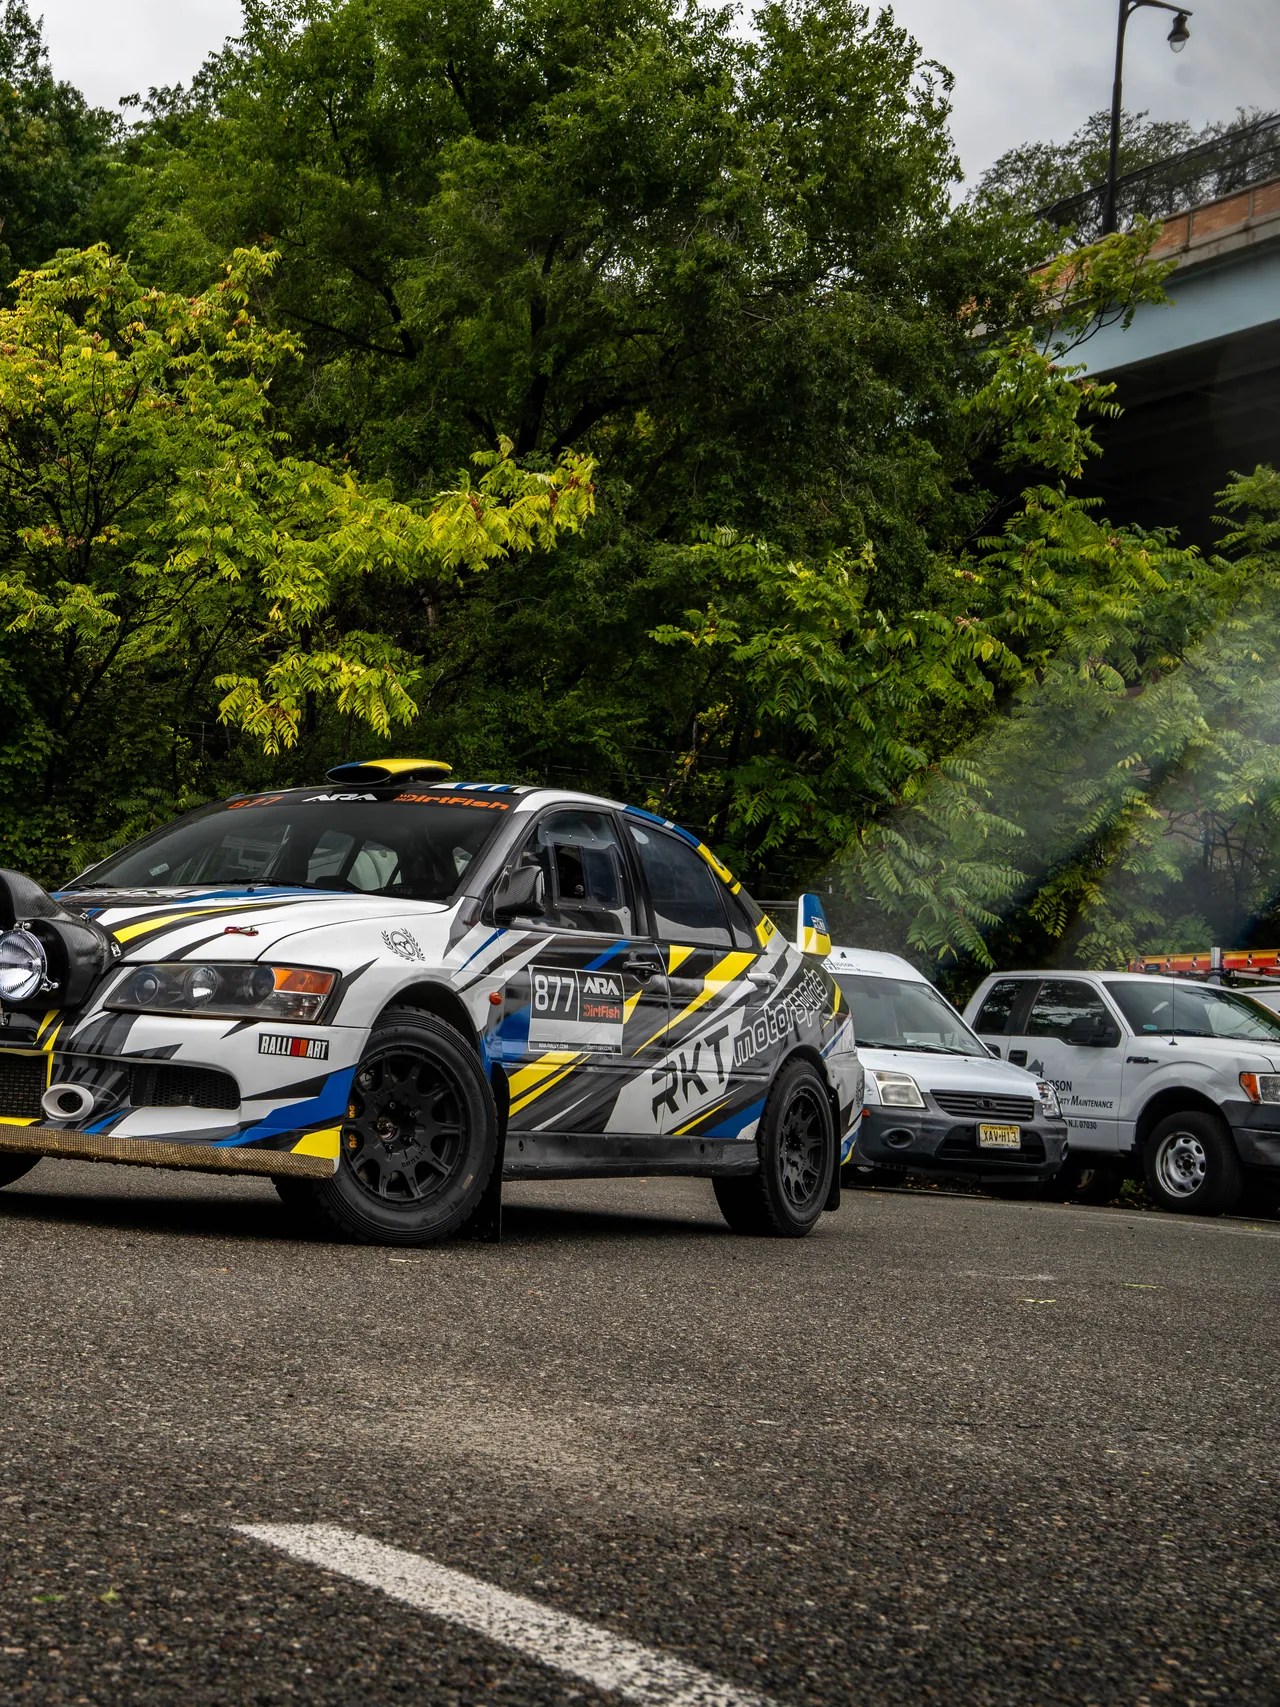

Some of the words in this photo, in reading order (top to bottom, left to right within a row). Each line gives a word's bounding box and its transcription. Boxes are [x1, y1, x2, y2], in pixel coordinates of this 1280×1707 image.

[227, 796, 284, 810] 877
[302, 793, 378, 801] ARA
[393, 794, 510, 811] DirtFish
[534, 974, 575, 1013] 877
[583, 976, 620, 996] ARA
[583, 1004, 620, 1019] DirtFish
[652, 1024, 729, 1123] RKT
[1079, 1121, 1097, 1130] 07030
